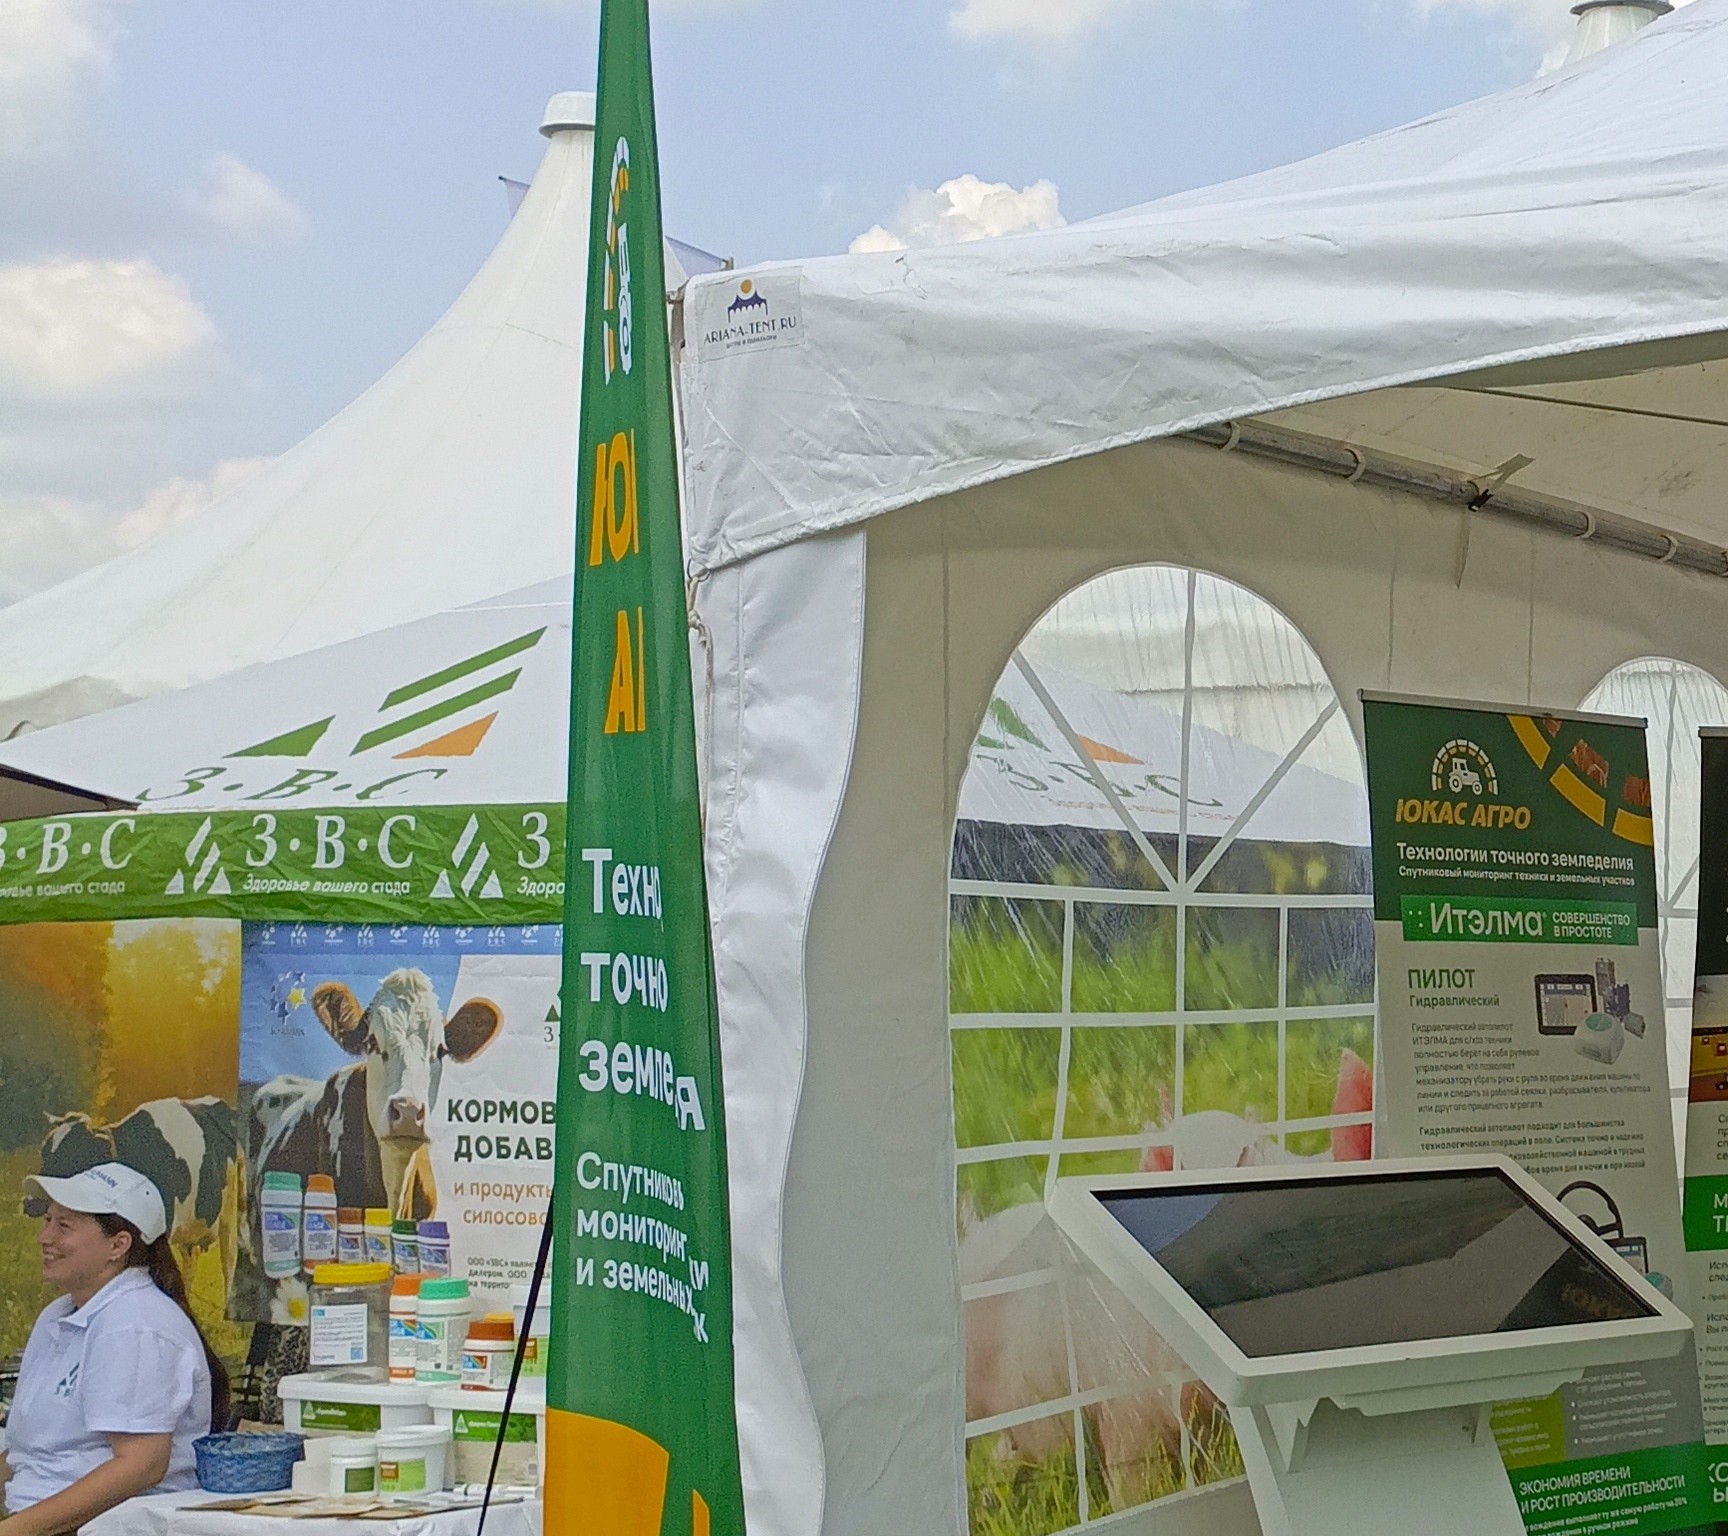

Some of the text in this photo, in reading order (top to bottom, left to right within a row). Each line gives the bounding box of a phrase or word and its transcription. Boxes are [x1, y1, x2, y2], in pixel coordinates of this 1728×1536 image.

[1396, 798, 1531, 830] ЮКАС АГРО
[1397, 843, 1634, 870] Технологии точного земледелия
[243, 874, 410, 895] Здоровье вашего стада
[1399, 866, 1635, 886] Спутниковый мониторинг техники земельных участков
[1430, 903, 1544, 936] Итэлма
[1552, 912, 1630, 926] СОВЕРШЕНСТВО
[1408, 969, 1475, 989] ПИЛОТ
[1410, 995, 1500, 1009] Гидравлический
[454, 1135, 553, 1162] ДОБАВ
[467, 1257, 484, 1265] ООО
[577, 1257, 593, 1286] и
[1707, 1324, 1720, 1334] Вы
[1519, 1466, 1631, 1496] ЭКОНОМИЯ ВРЕМЕНИ
[1531, 1475, 1685, 1512] РОСТ ПРОИЗВОДИТЕЛЬНОСТИ
